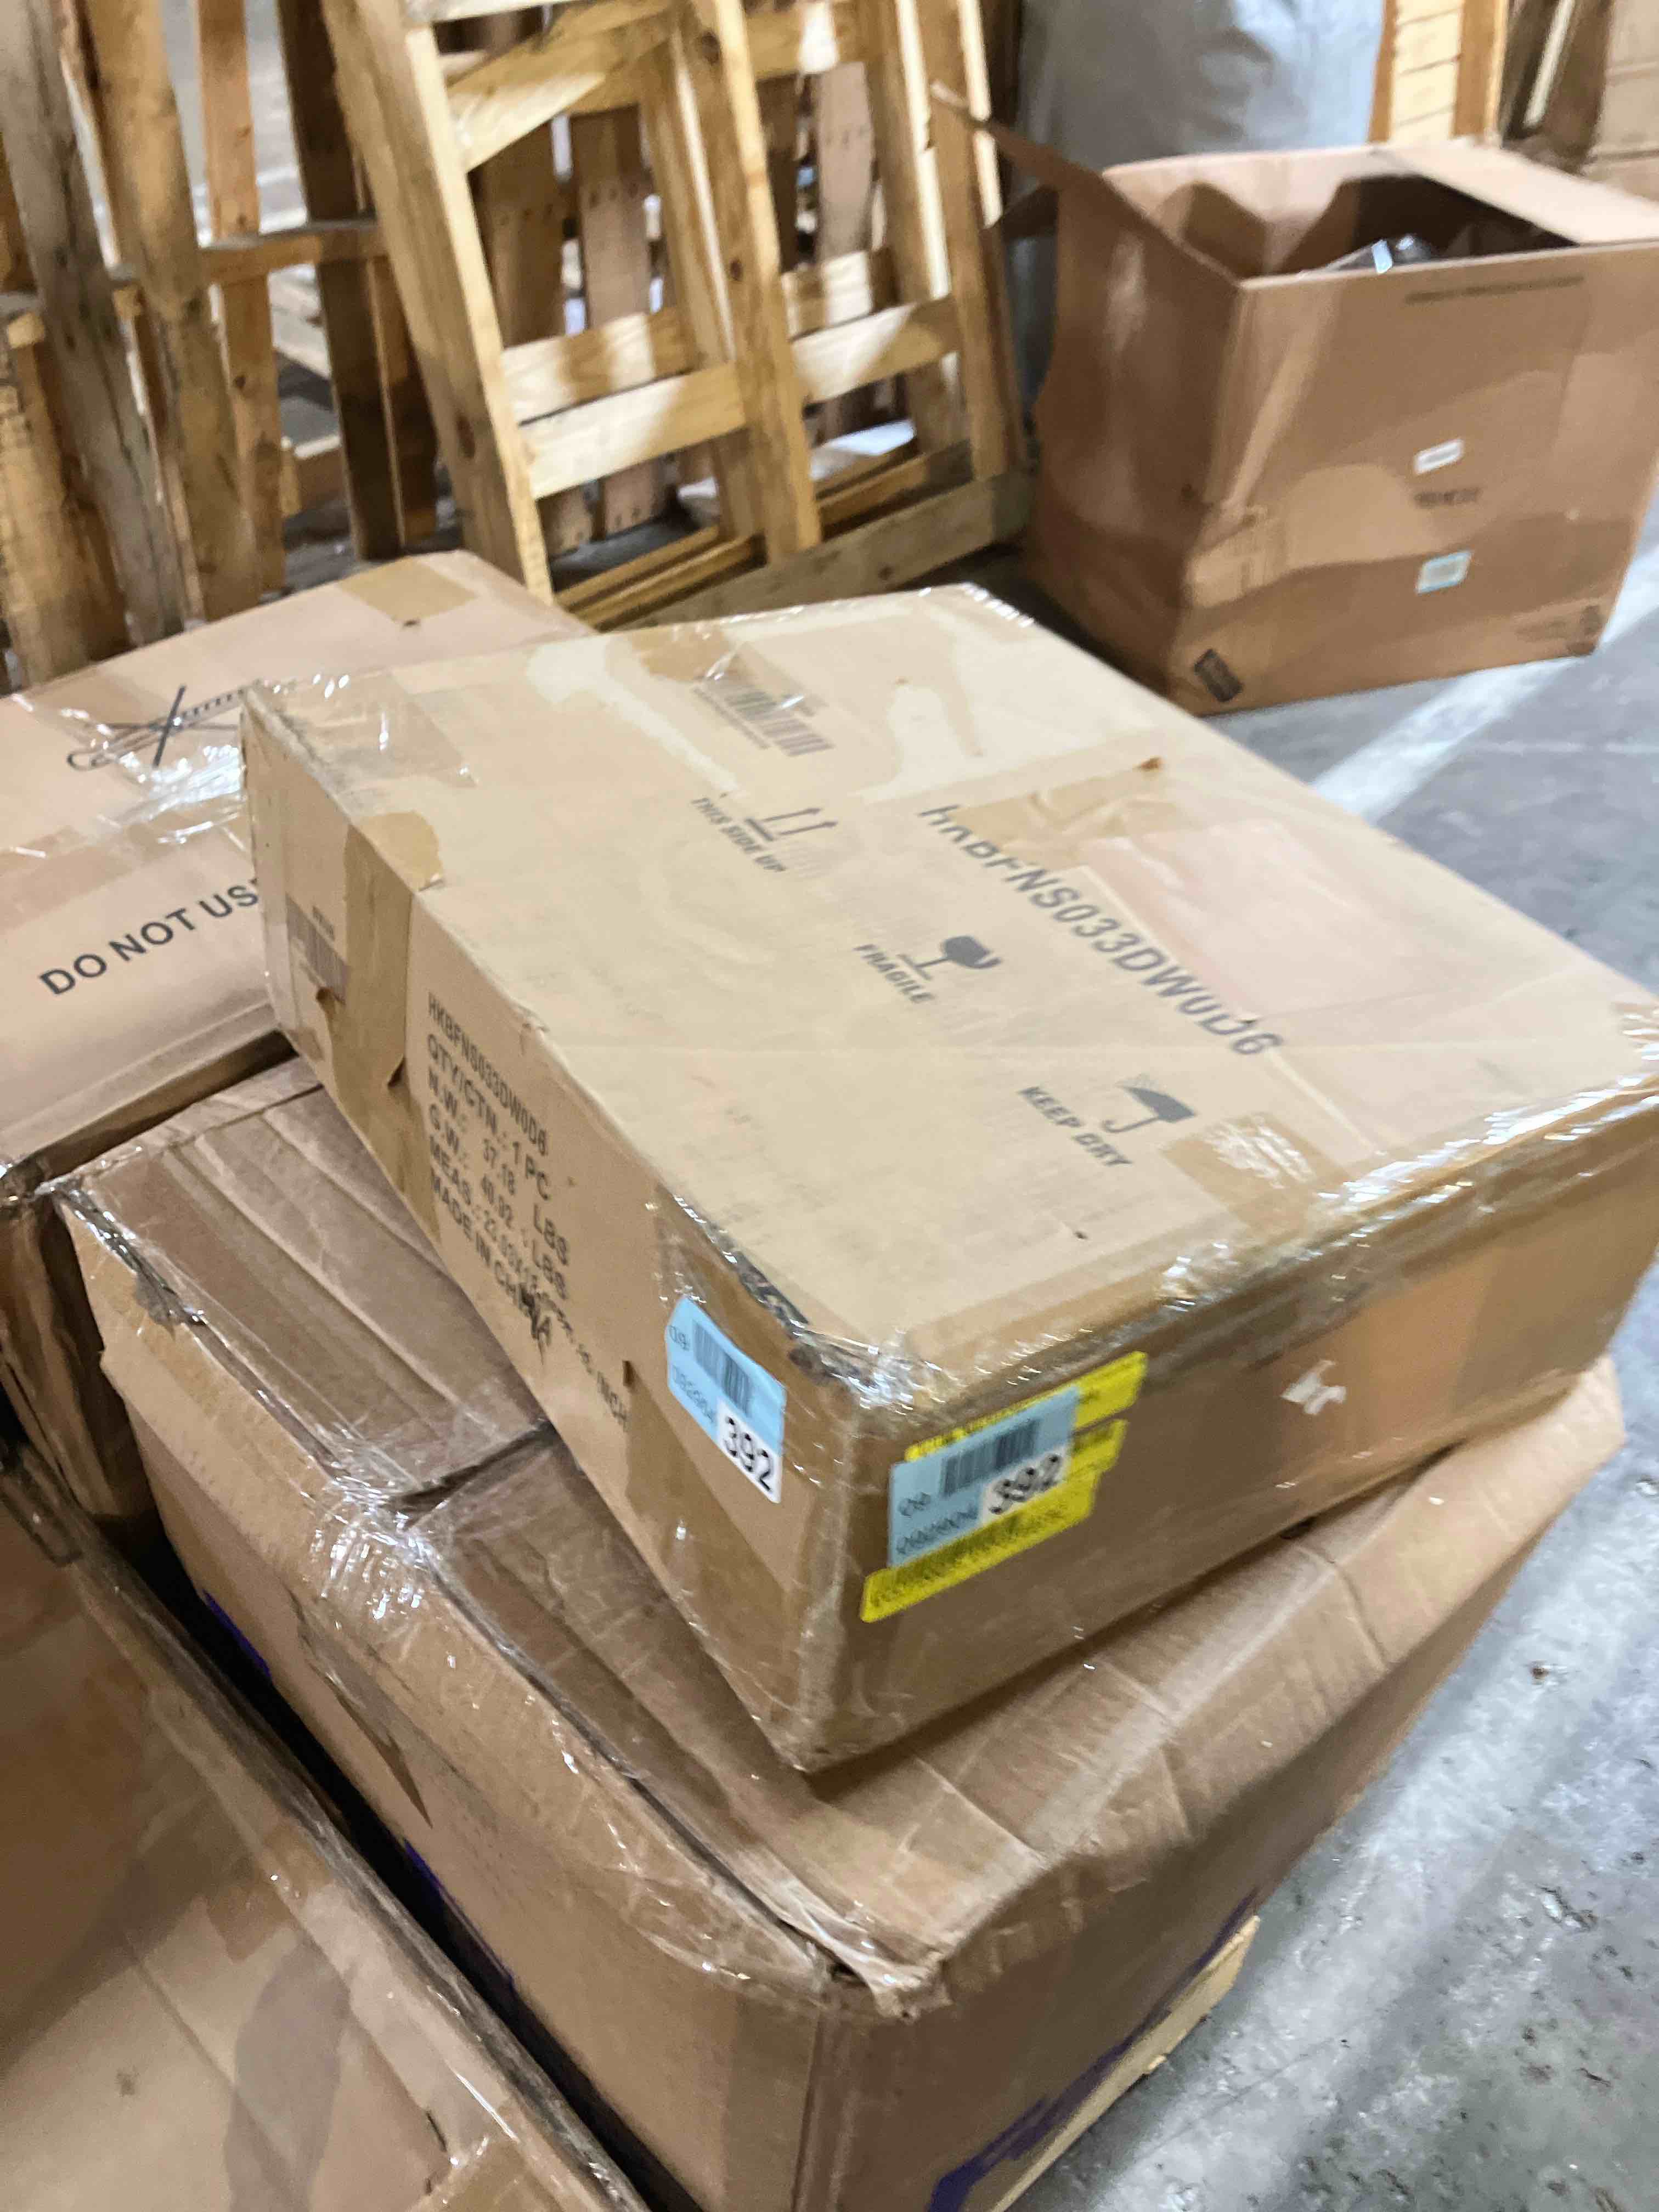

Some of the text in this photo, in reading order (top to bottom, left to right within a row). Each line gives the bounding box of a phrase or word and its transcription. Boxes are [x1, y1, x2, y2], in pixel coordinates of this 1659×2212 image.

[39, 878, 258, 995] DO NOT US
[1016, 1086, 1133, 1166] KEEP DRY
[525, 1154, 550, 1200] PC
[430, 1165, 551, 1347] MADE IN CHA
[532, 1239, 567, 1300] LBS
[533, 1204, 567, 1265] LBS
[724, 1416, 774, 1493] 392
[988, 1451, 1064, 1515] 392
